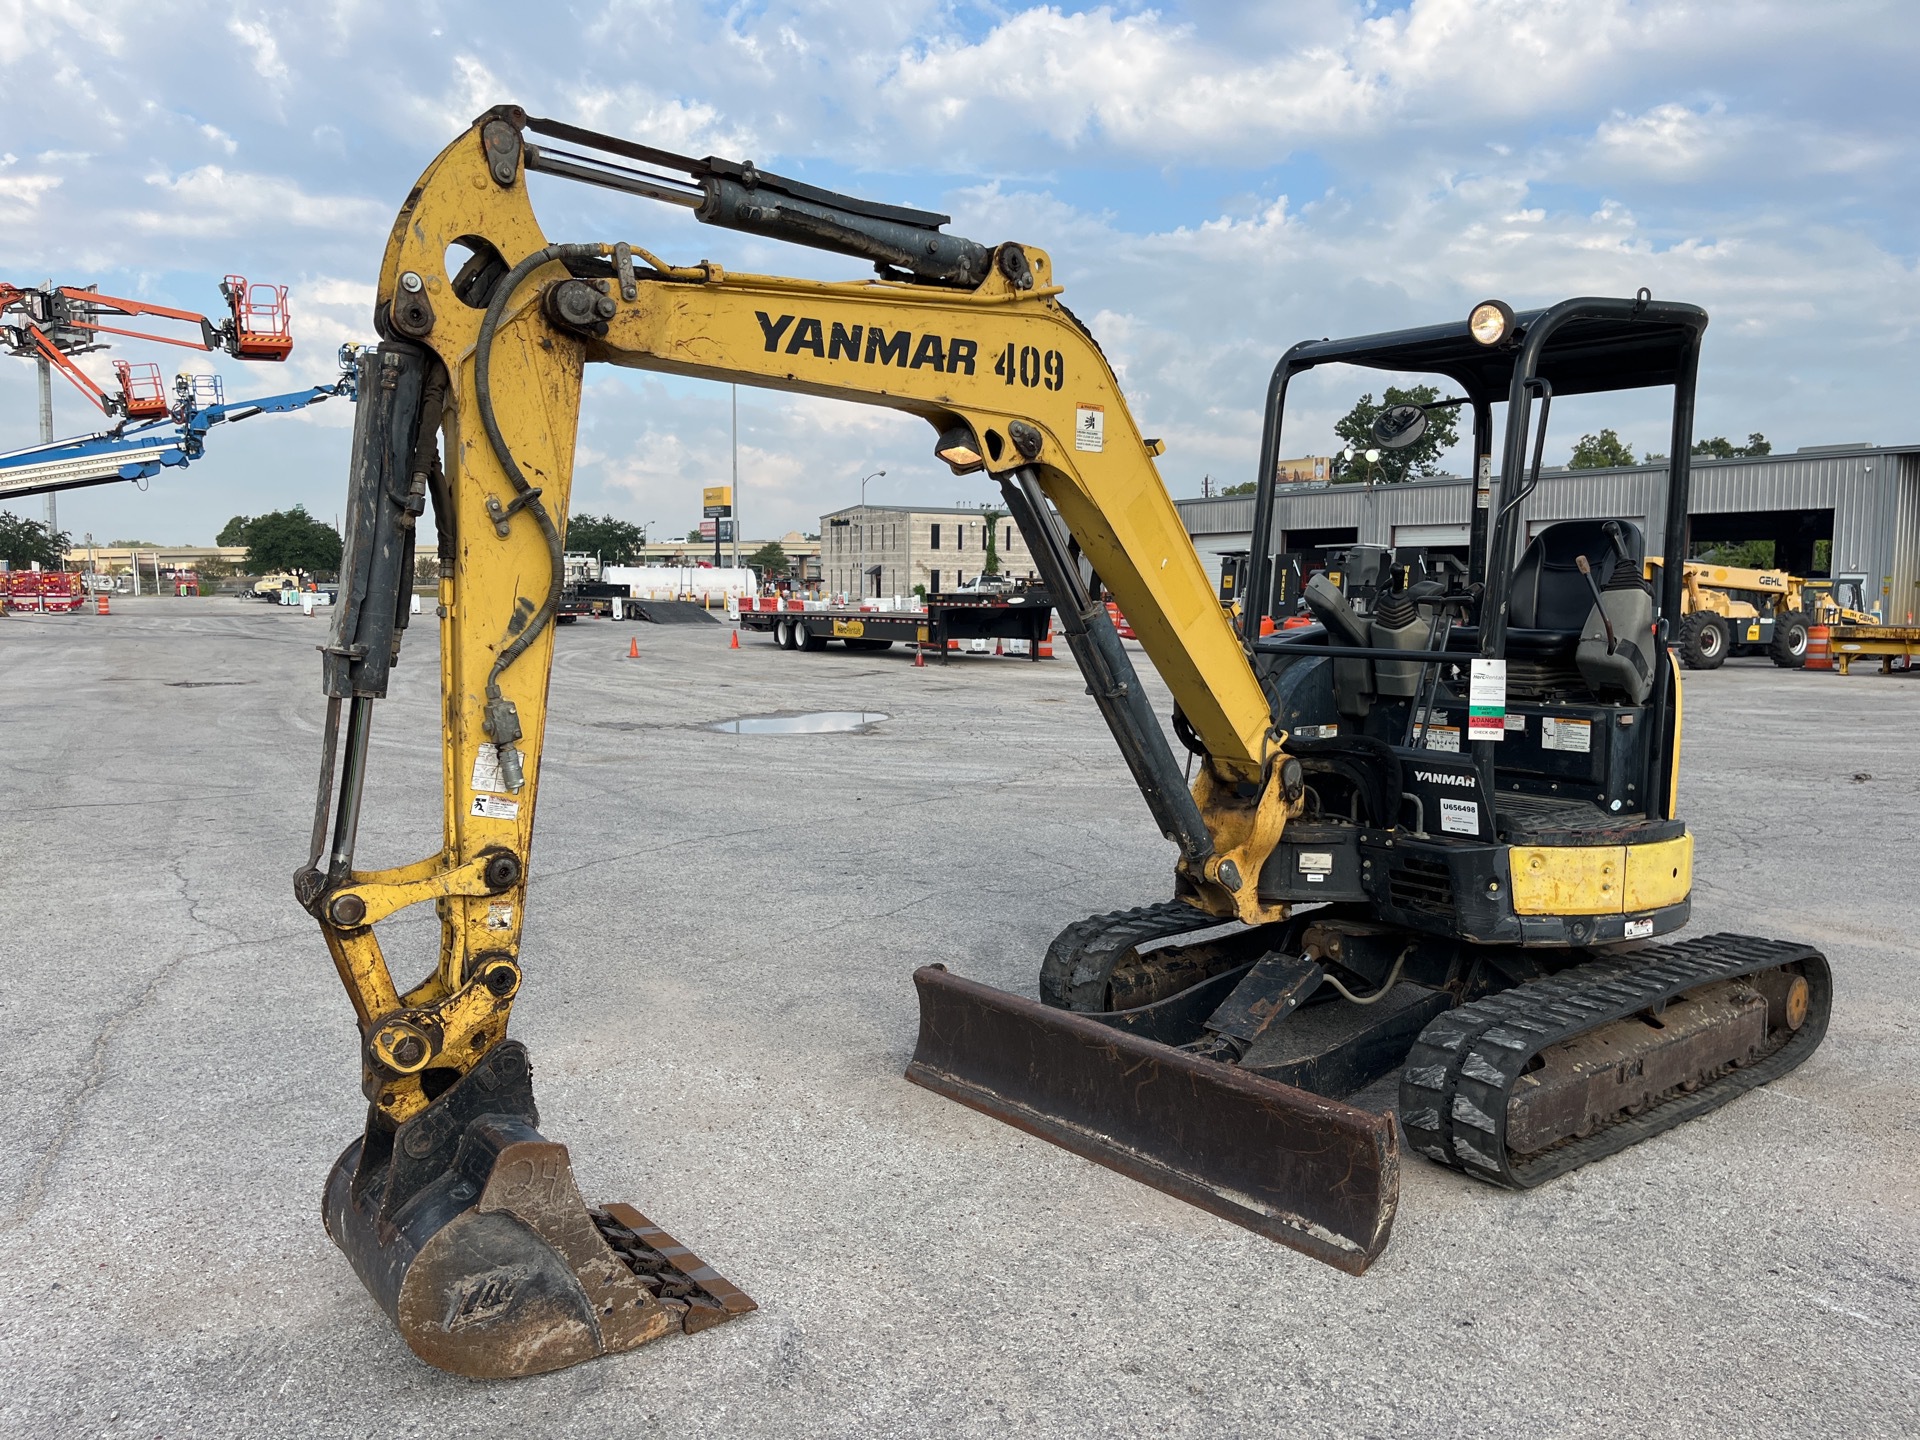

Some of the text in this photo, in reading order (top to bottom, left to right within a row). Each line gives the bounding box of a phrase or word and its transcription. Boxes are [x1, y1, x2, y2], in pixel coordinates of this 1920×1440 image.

[754, 311, 1064, 391] YANMAR 409
[1759, 576, 1782, 587] GEHL
[1859, 614, 1875, 624] GEHL
[1414, 771, 1476, 787] YANMAR
[1443, 803, 1476, 813] U656498
